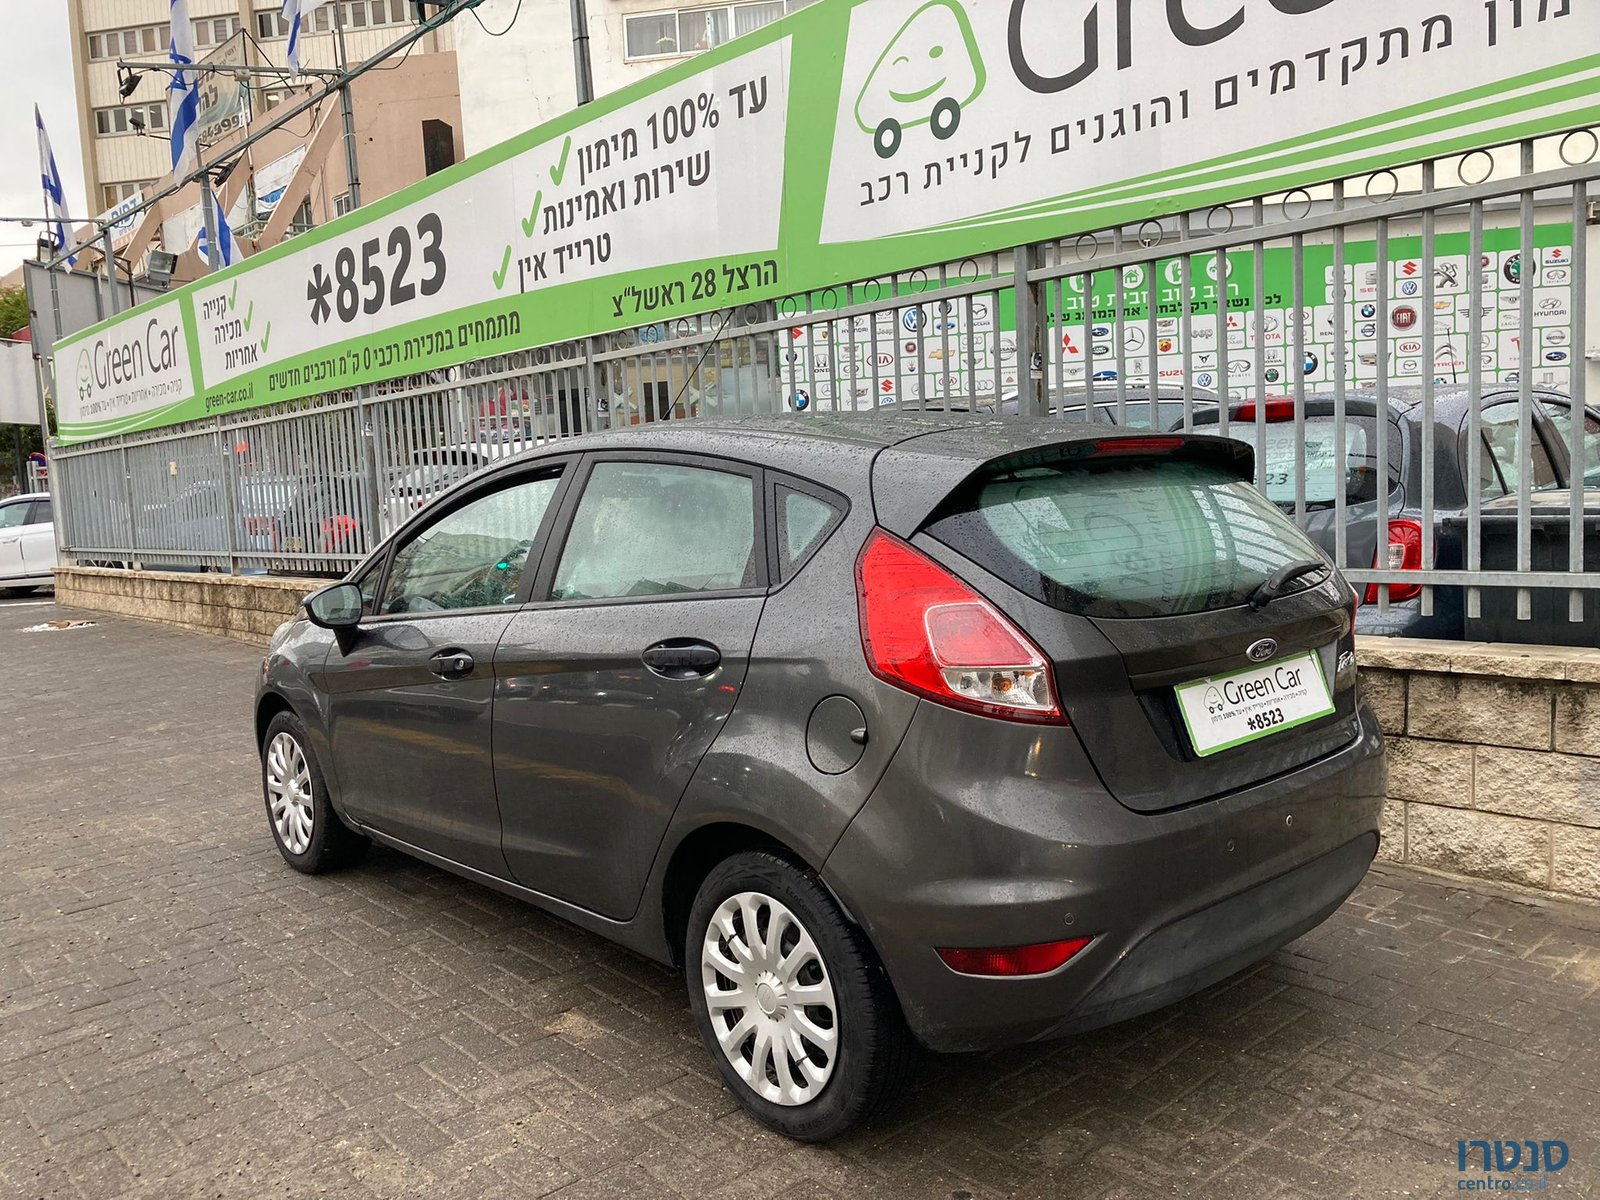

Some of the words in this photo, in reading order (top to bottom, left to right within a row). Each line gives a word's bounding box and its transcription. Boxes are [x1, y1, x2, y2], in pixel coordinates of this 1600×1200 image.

[1215, 13, 1452, 110] מתקדמים
[728, 75, 767, 118] עד
[647, 92, 720, 150] 100%
[1051, 89, 1189, 155] והוגנים
[577, 127, 638, 186] מימון
[923, 129, 1032, 190] לקניית
[633, 150, 711, 206] שירות
[860, 170, 909, 206] רכב
[543, 179, 626, 235] ואמינות
[553, 232, 611, 274] טרייד
[517, 252, 548, 294] אין
[691, 268, 717, 301] 28
[722, 259, 778, 293] הרצל
[203, 295, 227, 320] קנייה
[1396, 312, 1411, 324] FIAT
[214, 319, 242, 344] מכירה
[404, 328, 454, 361] במכירת
[458, 310, 521, 347] מתמחים
[94, 340, 144, 389] Green
[146, 318, 179, 373] Car
[225, 343, 258, 370] אחריות
[303, 358, 336, 384] ורכבים
[363, 346, 371, 371] 0
[373, 342, 400, 367] רכבי
[205, 381, 254, 413] green-car.co.il
[269, 369, 300, 391] חדשים
[1223, 677, 1275, 704] Green
[1274, 667, 1302, 690] Car
